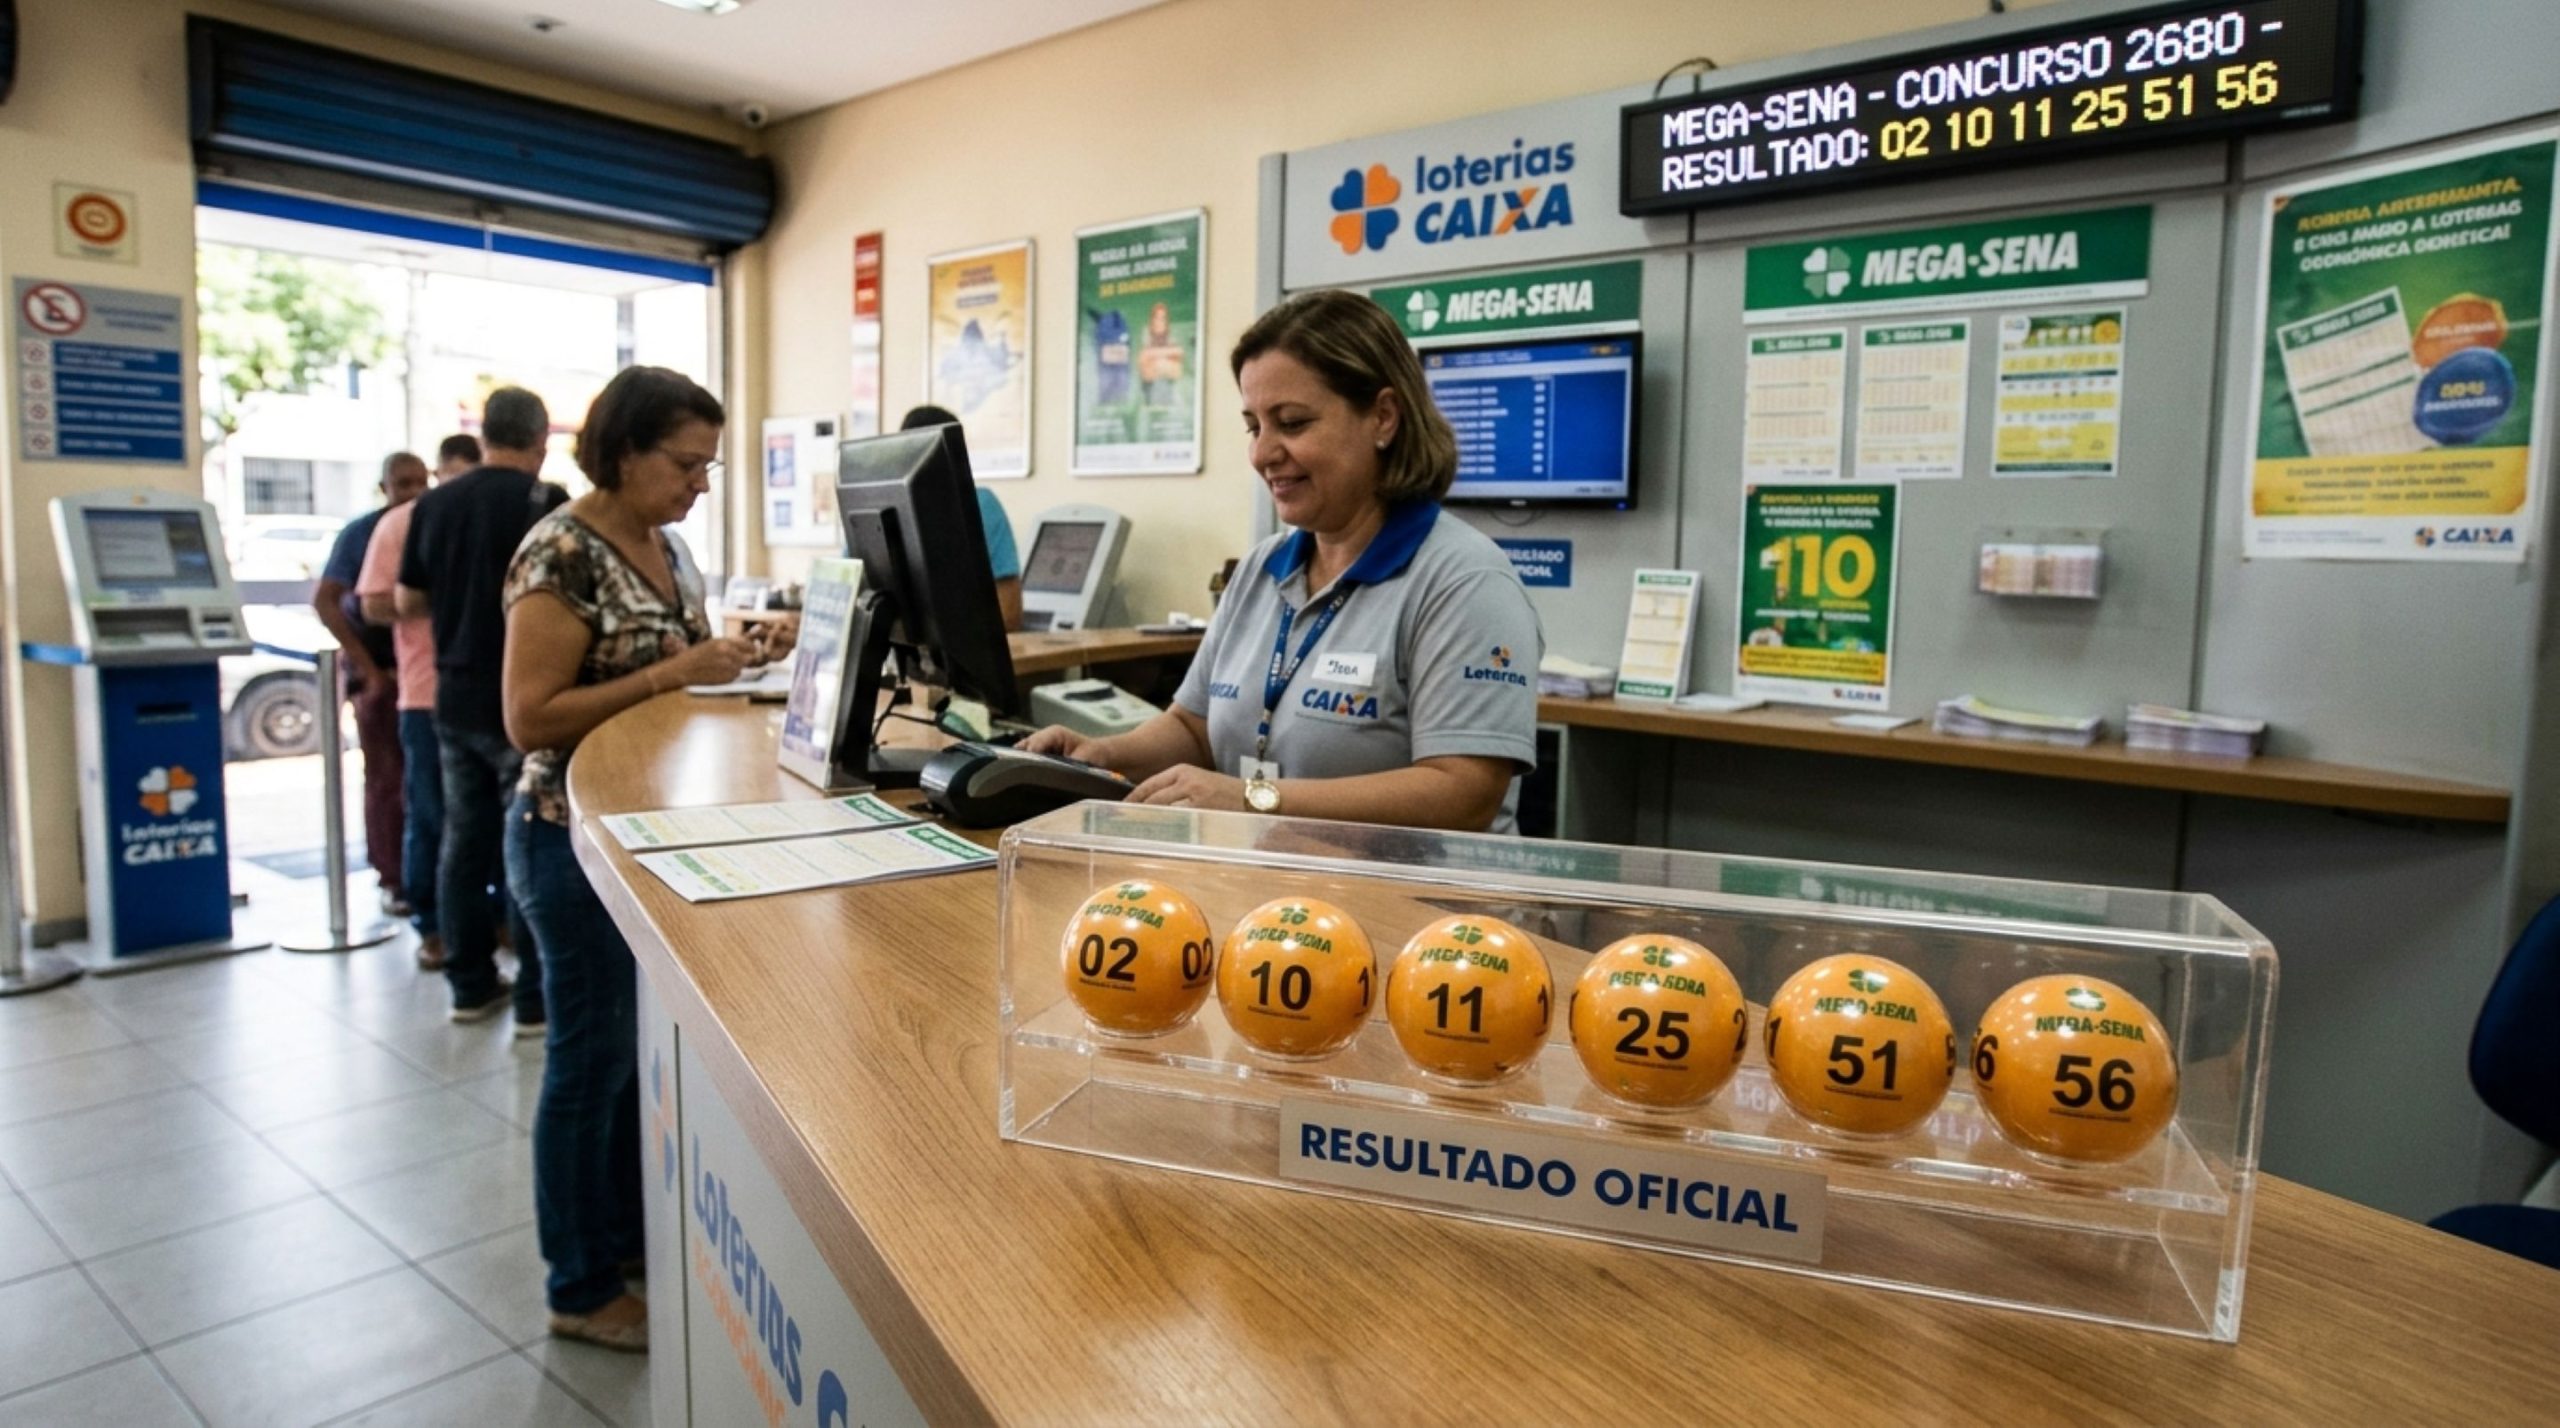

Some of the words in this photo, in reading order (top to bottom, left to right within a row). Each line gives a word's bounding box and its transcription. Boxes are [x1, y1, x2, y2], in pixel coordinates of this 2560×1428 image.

[1662, 82, 1856, 148] MEGA-SENA
[1896, 36, 2112, 109] CONCURSO
[2125, 12, 2245, 72] 2680
[1662, 128, 1869, 192] RESULTADO:
[1880, 116, 1931, 160] 02
[1946, 106, 1993, 150] 10
[2010, 97, 2051, 141] 11
[2071, 84, 2127, 133] 25
[2143, 74, 2194, 121] 51
[2216, 60, 2278, 110] 56
[1416, 138, 1575, 194] loterias
[1415, 182, 1573, 244] CAIXA
[2443, 527, 2514, 543] CAIXA
[1302, 688, 1378, 719] CAIXA
[123, 836, 218, 865] CAIXA
[1079, 934, 1139, 982] 02
[1250, 961, 1312, 1011] 10
[1427, 983, 1483, 1033] 11
[1615, 1007, 1690, 1060] 25
[1827, 1034, 1897, 1090] 51
[2052, 1054, 2136, 1112] 56
[1301, 1123, 1576, 1198] RESULTADO
[1595, 1169, 1798, 1233] OFICIAL
